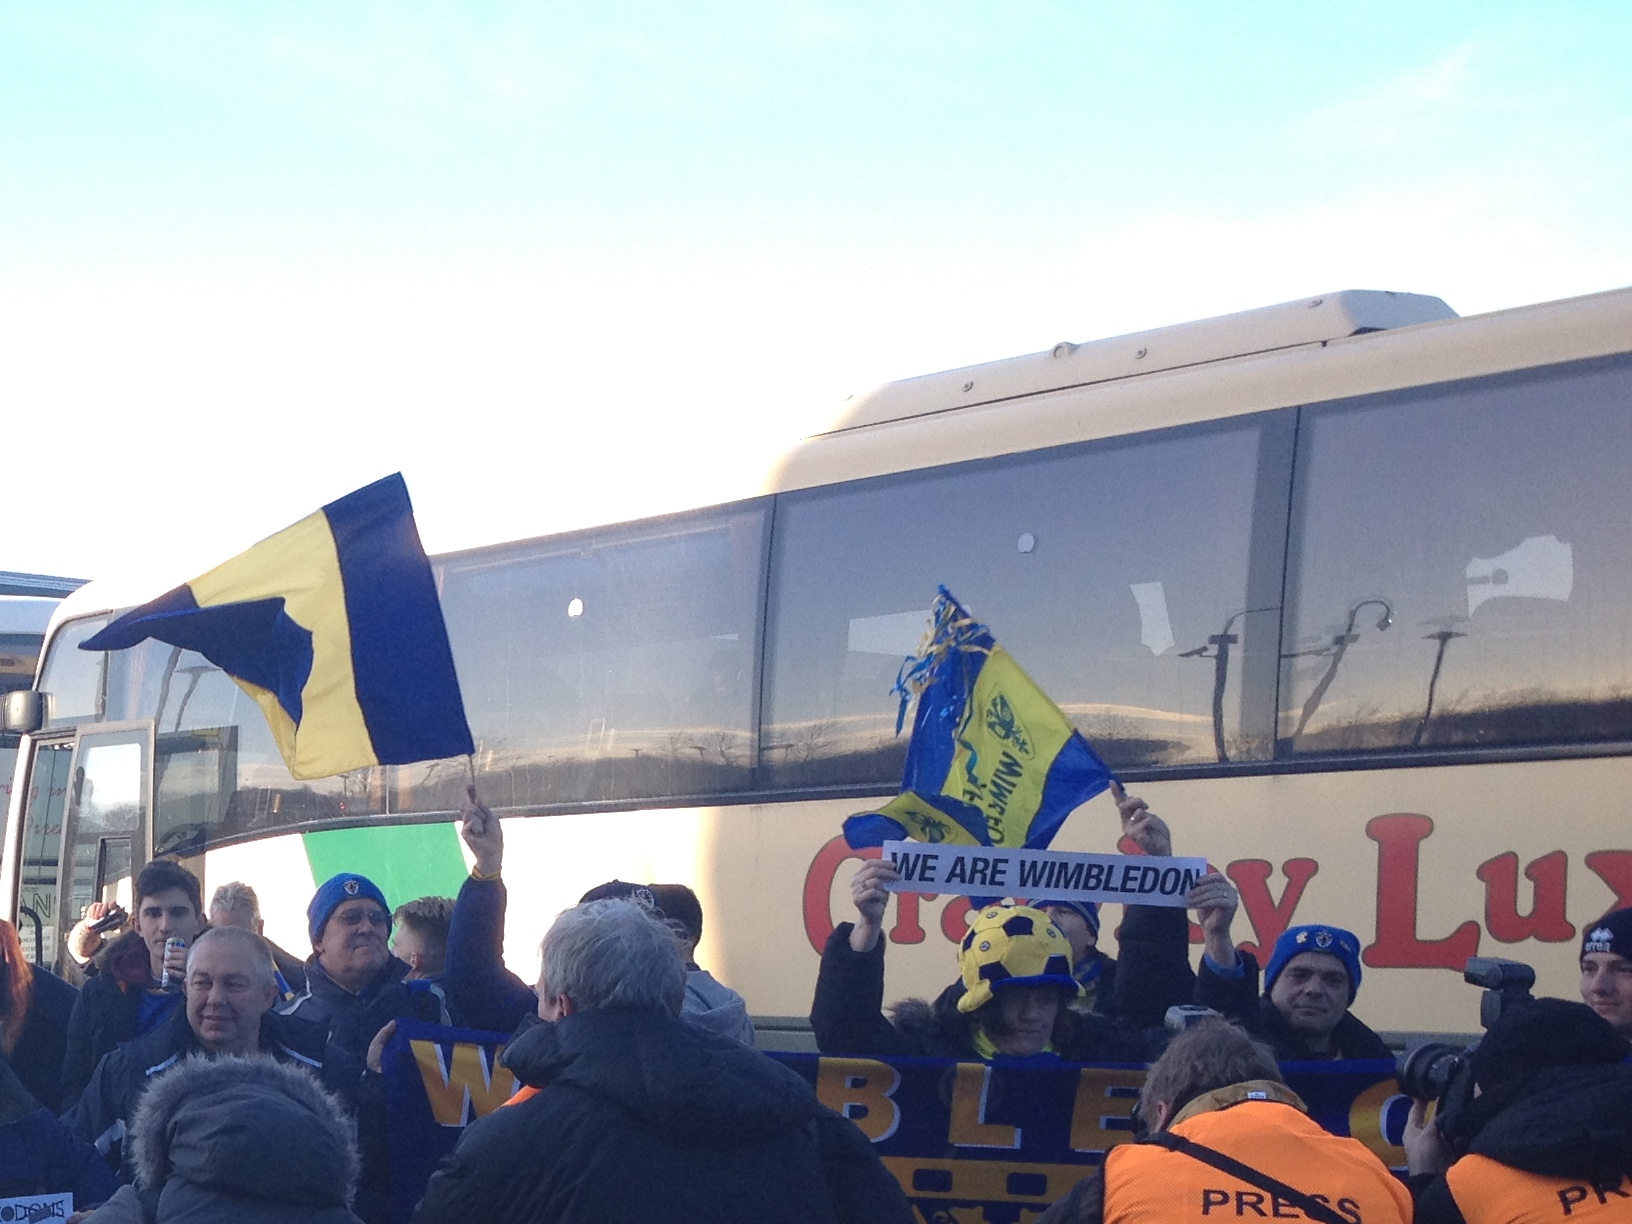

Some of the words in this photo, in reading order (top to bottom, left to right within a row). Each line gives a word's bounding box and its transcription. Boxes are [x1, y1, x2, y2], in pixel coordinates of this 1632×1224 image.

[890, 851, 940, 882] WE
[945, 857, 1008, 886] ARE
[1019, 859, 1201, 896] WIMBLEDON
